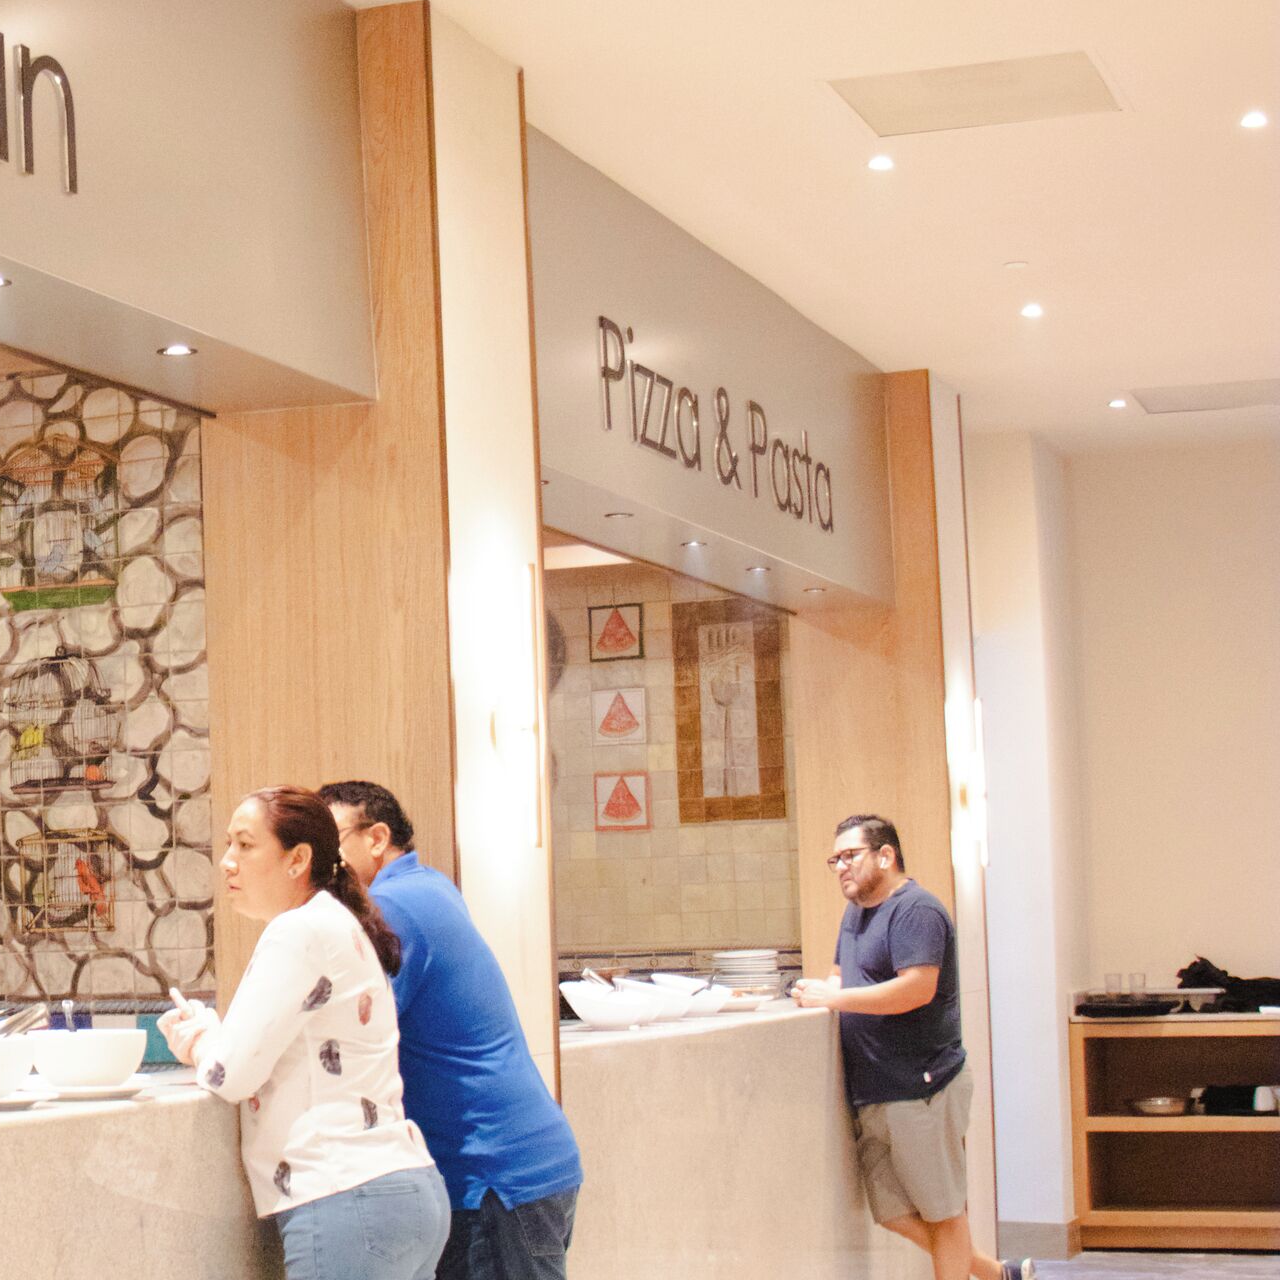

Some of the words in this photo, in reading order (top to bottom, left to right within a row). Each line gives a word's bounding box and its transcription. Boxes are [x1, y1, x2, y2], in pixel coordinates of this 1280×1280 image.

[598, 315, 701, 472] Pizza
[714, 386, 742, 490] &
[747, 399, 834, 533] Pasta
